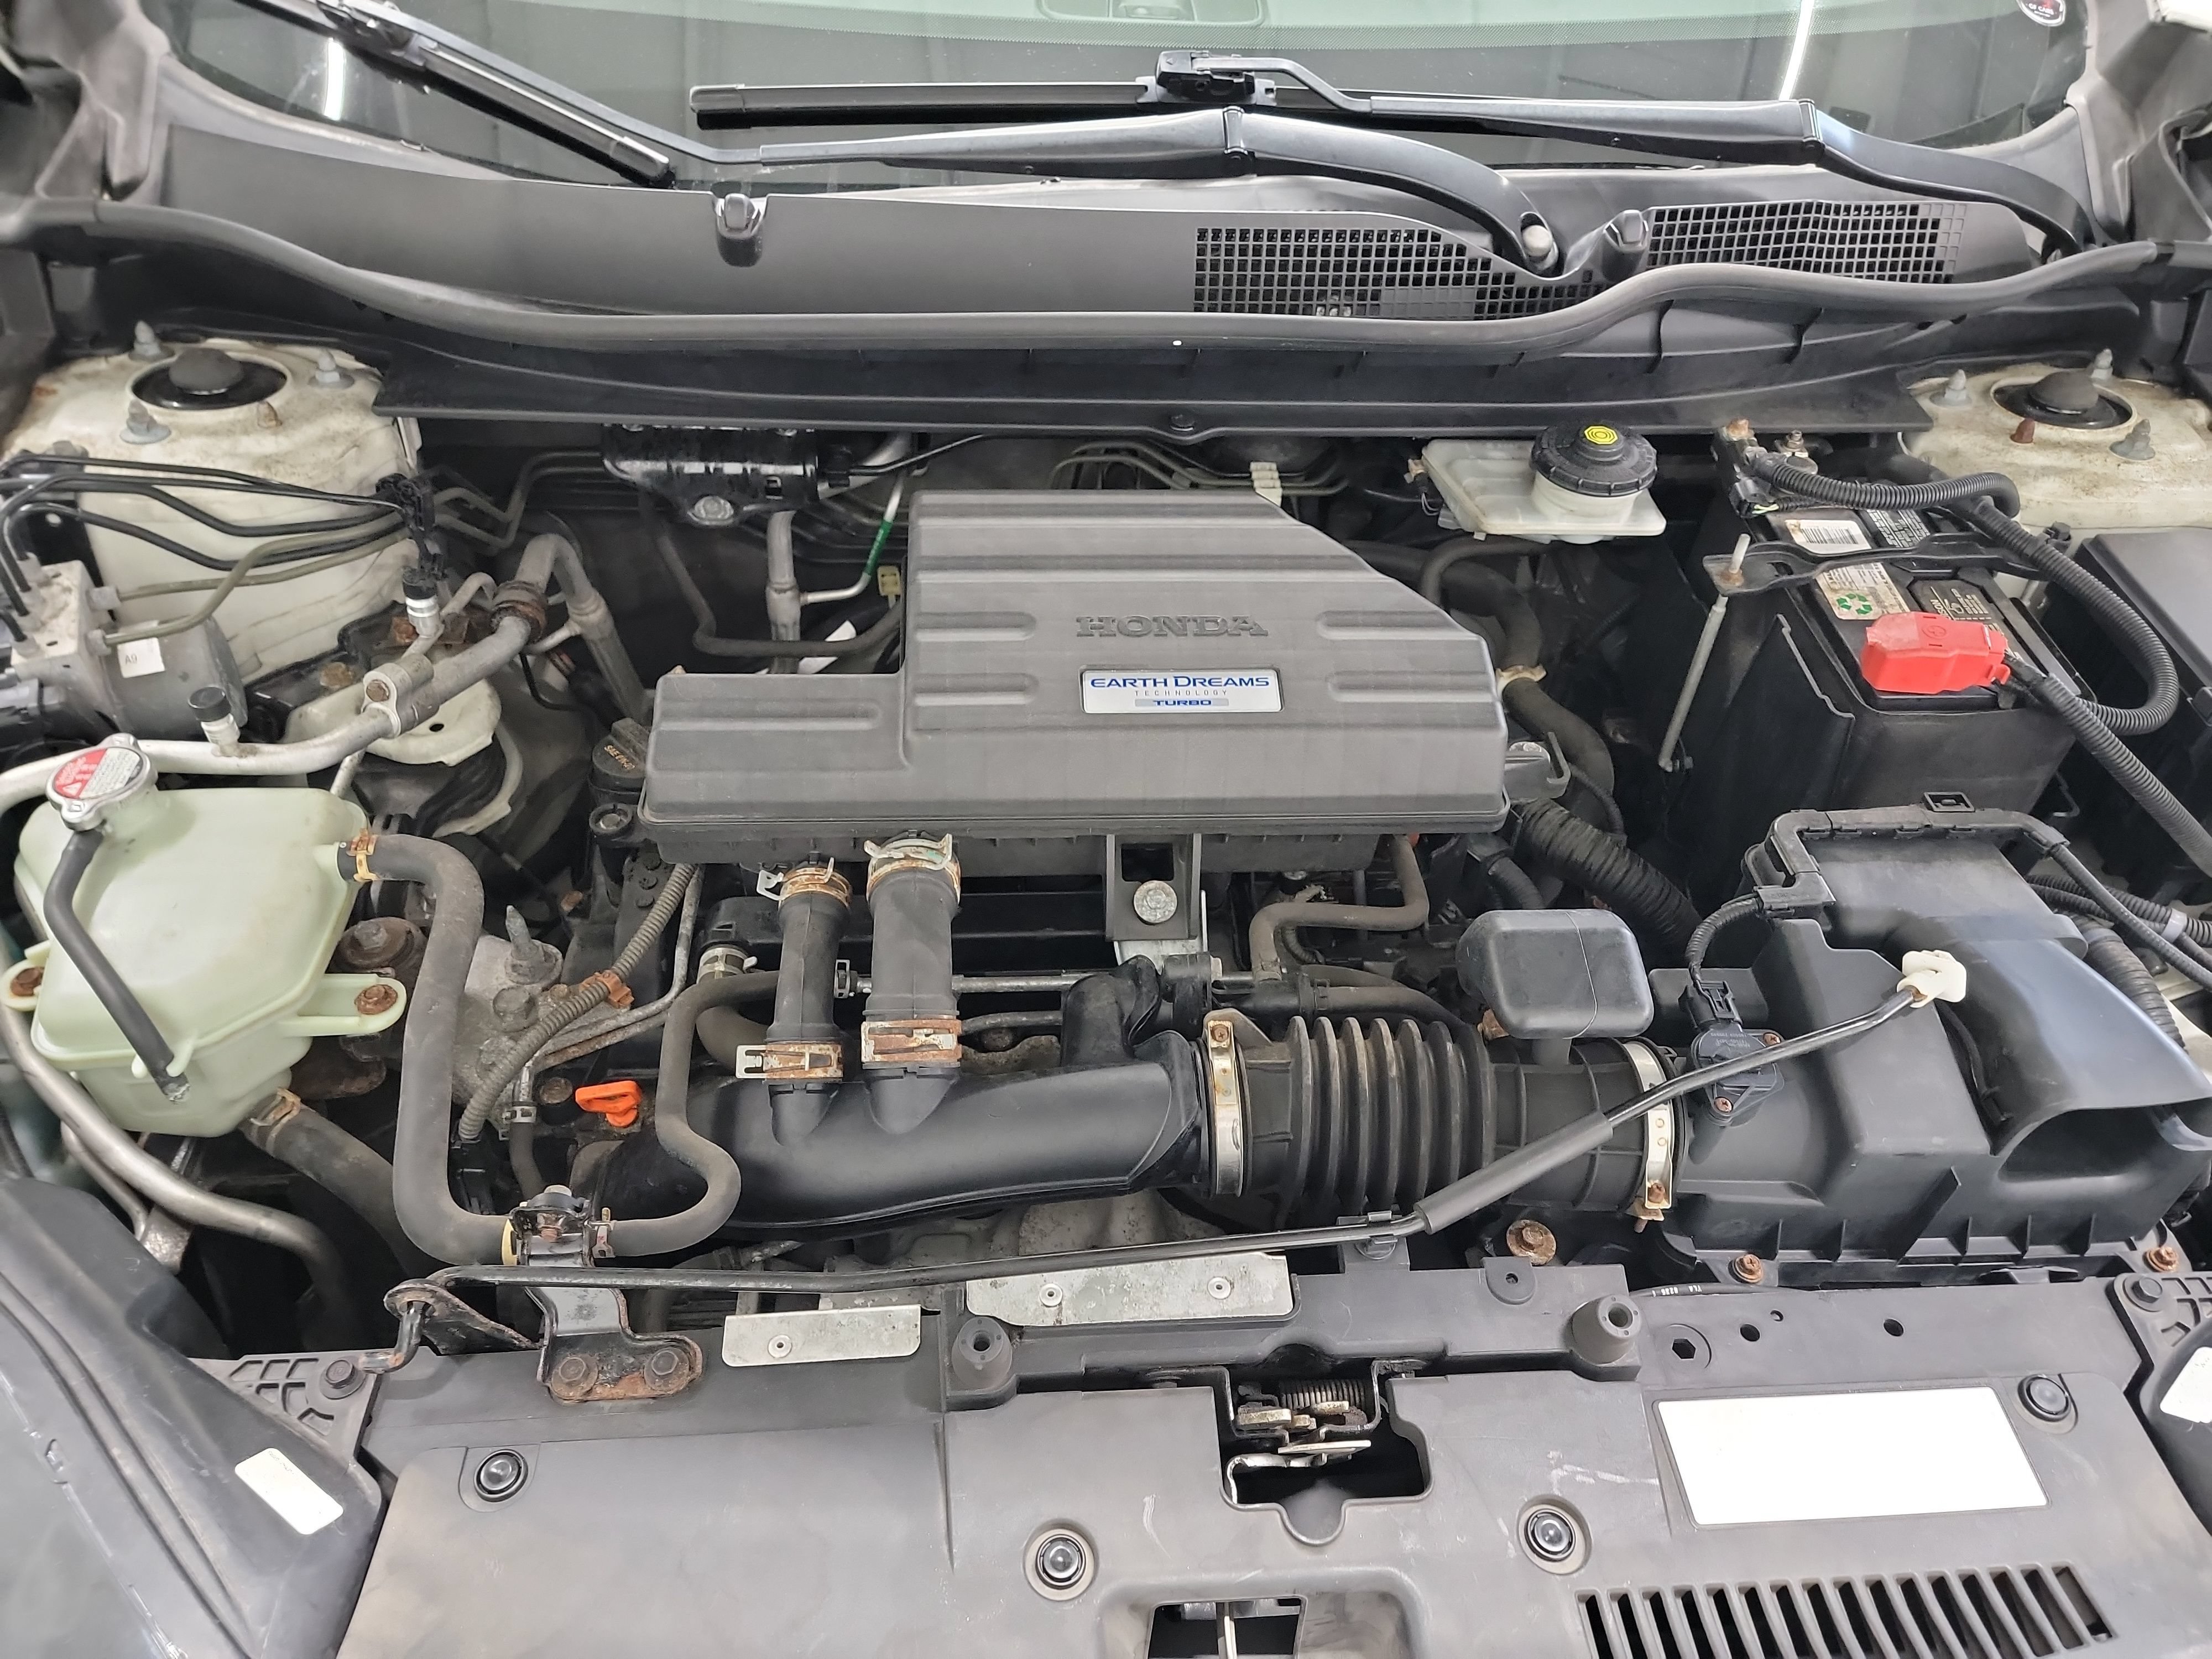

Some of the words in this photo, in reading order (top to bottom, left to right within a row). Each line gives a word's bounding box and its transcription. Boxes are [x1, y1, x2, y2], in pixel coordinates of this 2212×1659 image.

[1076, 615, 1269, 637] HONDA
[1091, 678, 1167, 687] EARTH
[1174, 676, 1269, 687] DREAMS
